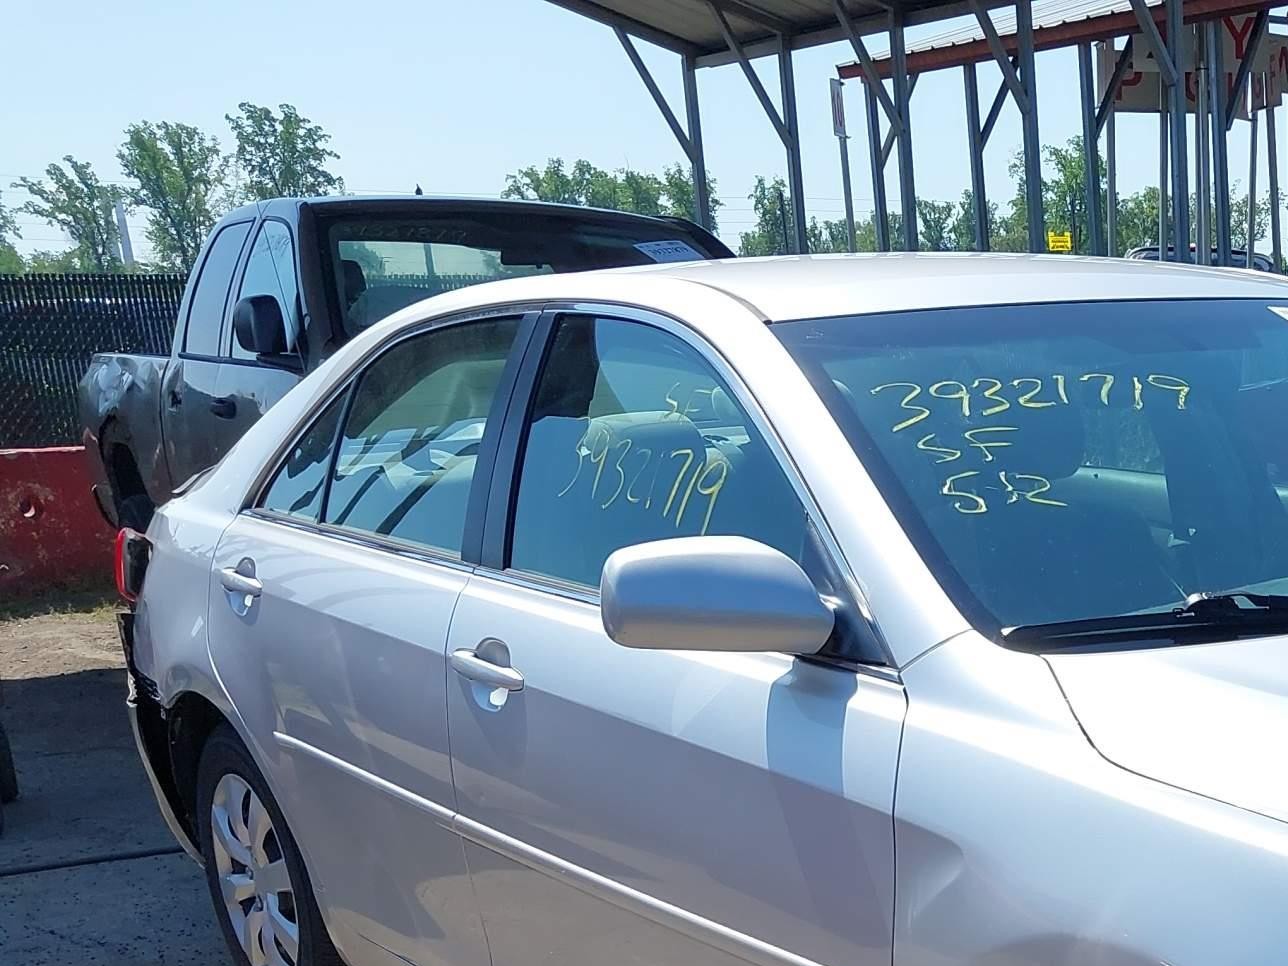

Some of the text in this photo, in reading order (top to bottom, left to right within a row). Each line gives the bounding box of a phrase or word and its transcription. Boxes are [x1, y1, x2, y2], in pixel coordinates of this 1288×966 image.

[1223, 16, 1256, 60] Y
[870, 373, 1190, 432] 39321719
[916, 427, 1019, 464] SF
